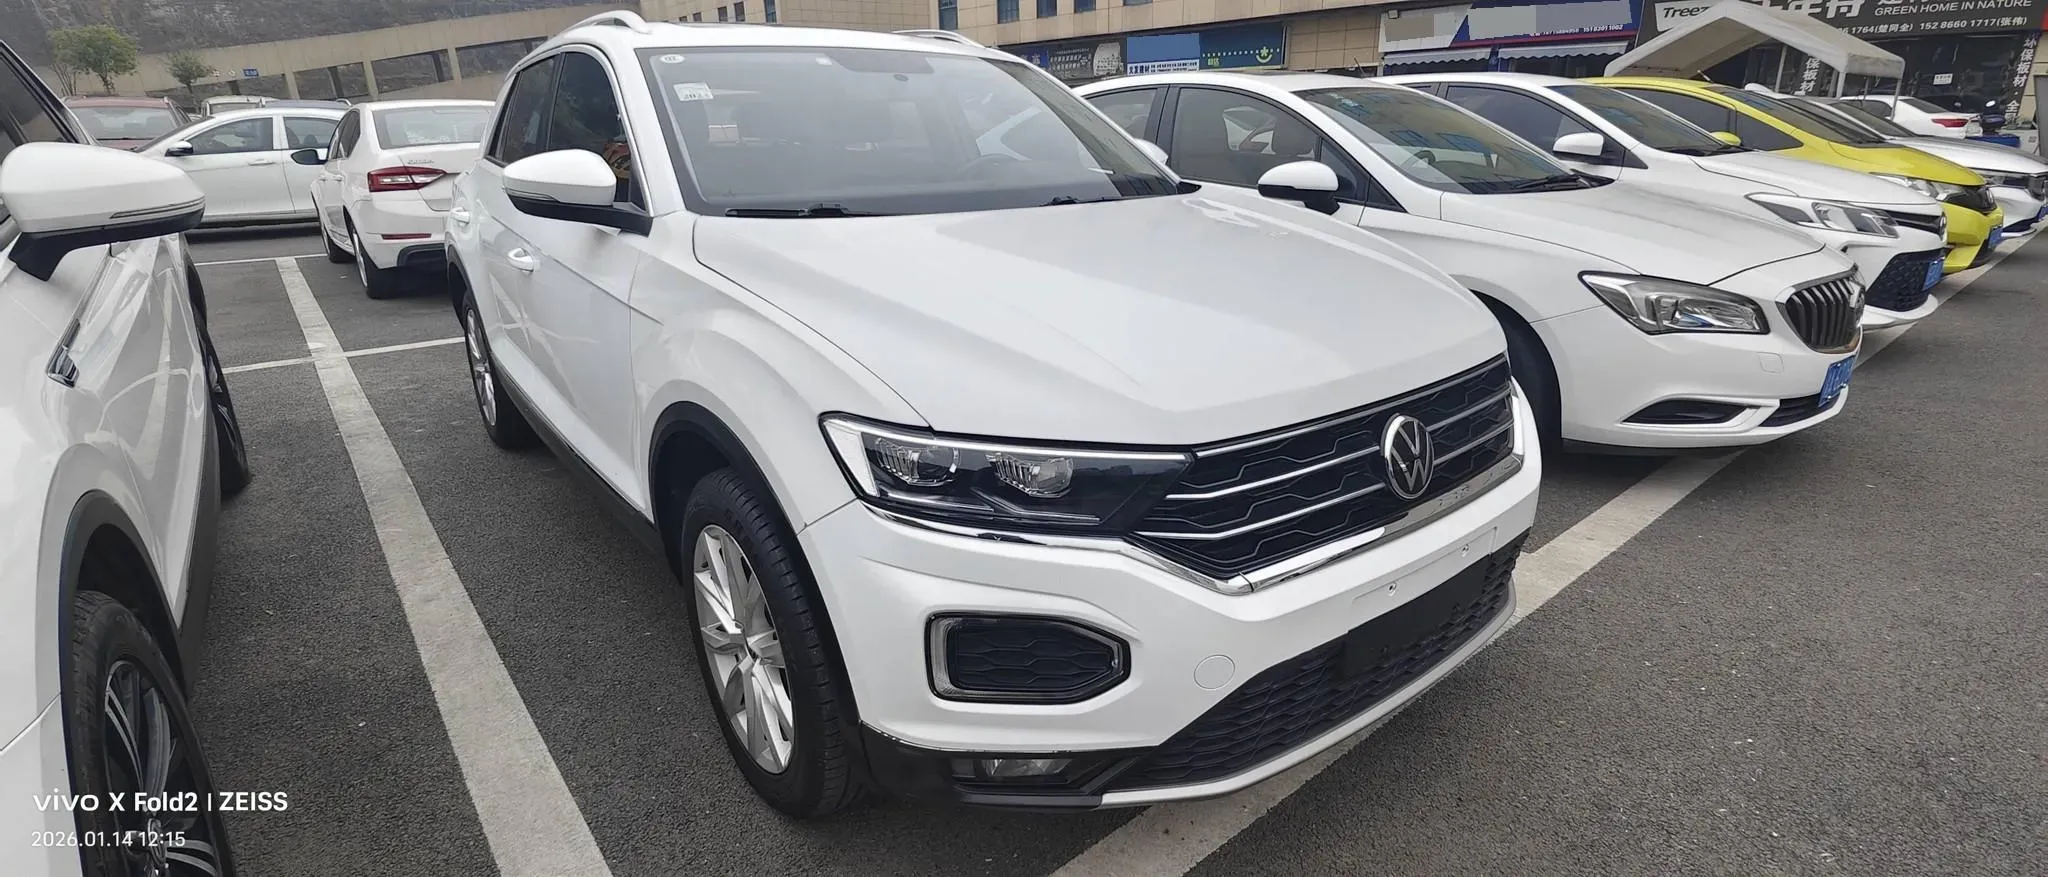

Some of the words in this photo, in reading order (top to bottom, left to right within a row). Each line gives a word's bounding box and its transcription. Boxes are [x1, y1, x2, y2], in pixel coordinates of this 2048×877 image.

[1875, 6, 1918, 16] GREEN
[1919, 2, 1959, 13] HOME
[1960, 1, 1974, 10] IN
[1977, 0, 2032, 10] NATURE
[1919, 22, 1939, 30] 152
[1940, 20, 1967, 29] 8660
